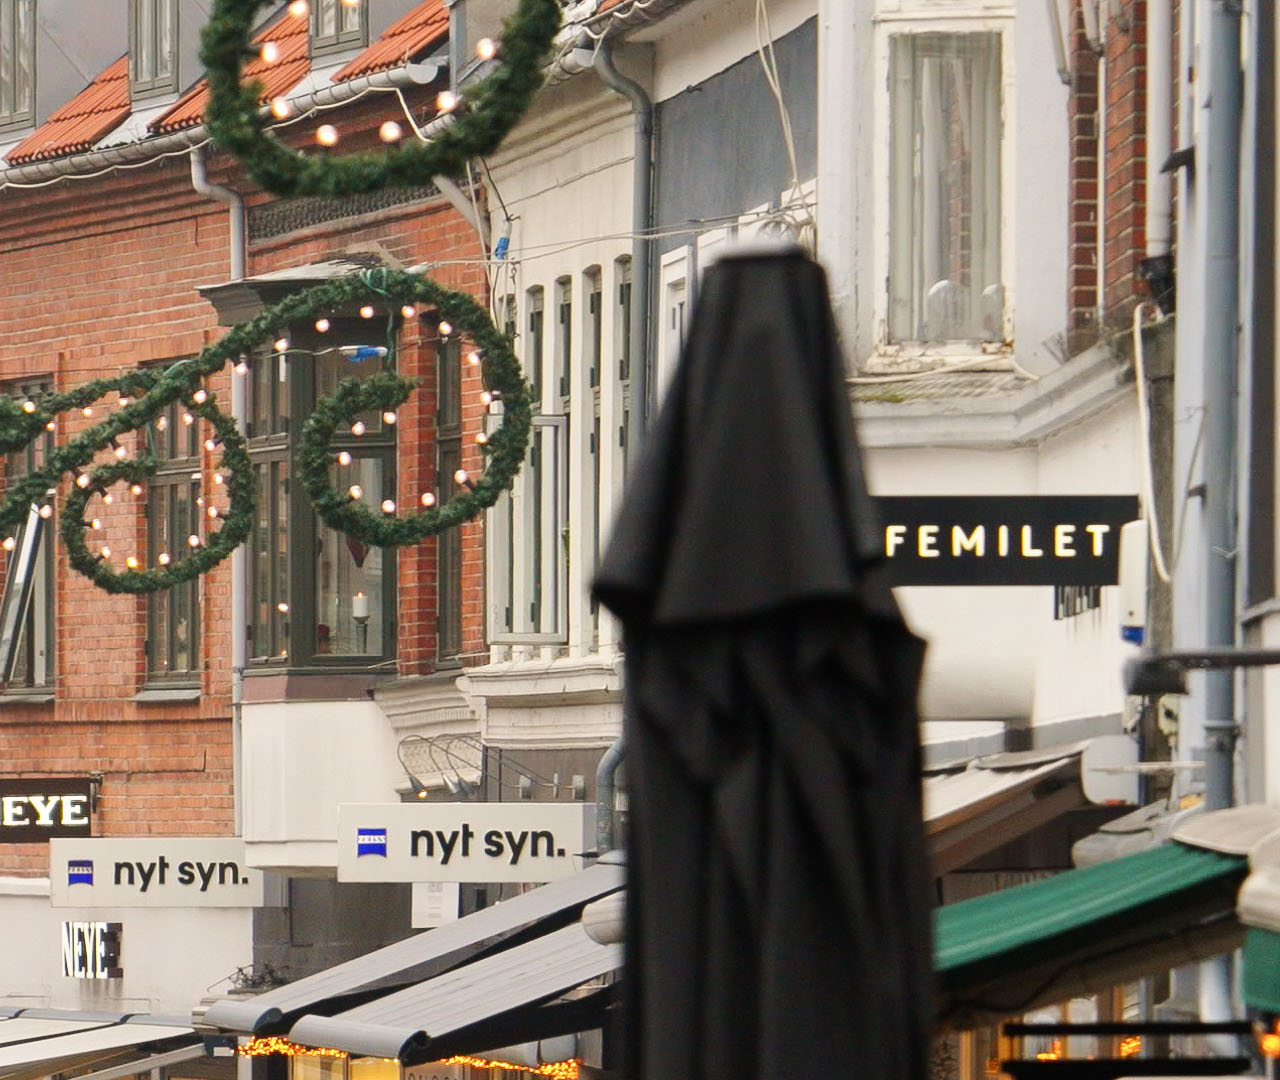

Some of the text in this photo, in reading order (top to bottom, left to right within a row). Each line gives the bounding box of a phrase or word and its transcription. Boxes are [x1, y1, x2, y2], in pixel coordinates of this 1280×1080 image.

[885, 524, 1110, 558] FEMILET
[411, 823, 565, 865] nyt syn.
[114, 856, 249, 892] nyt syn.
[61, 921, 108, 979] NEYE
